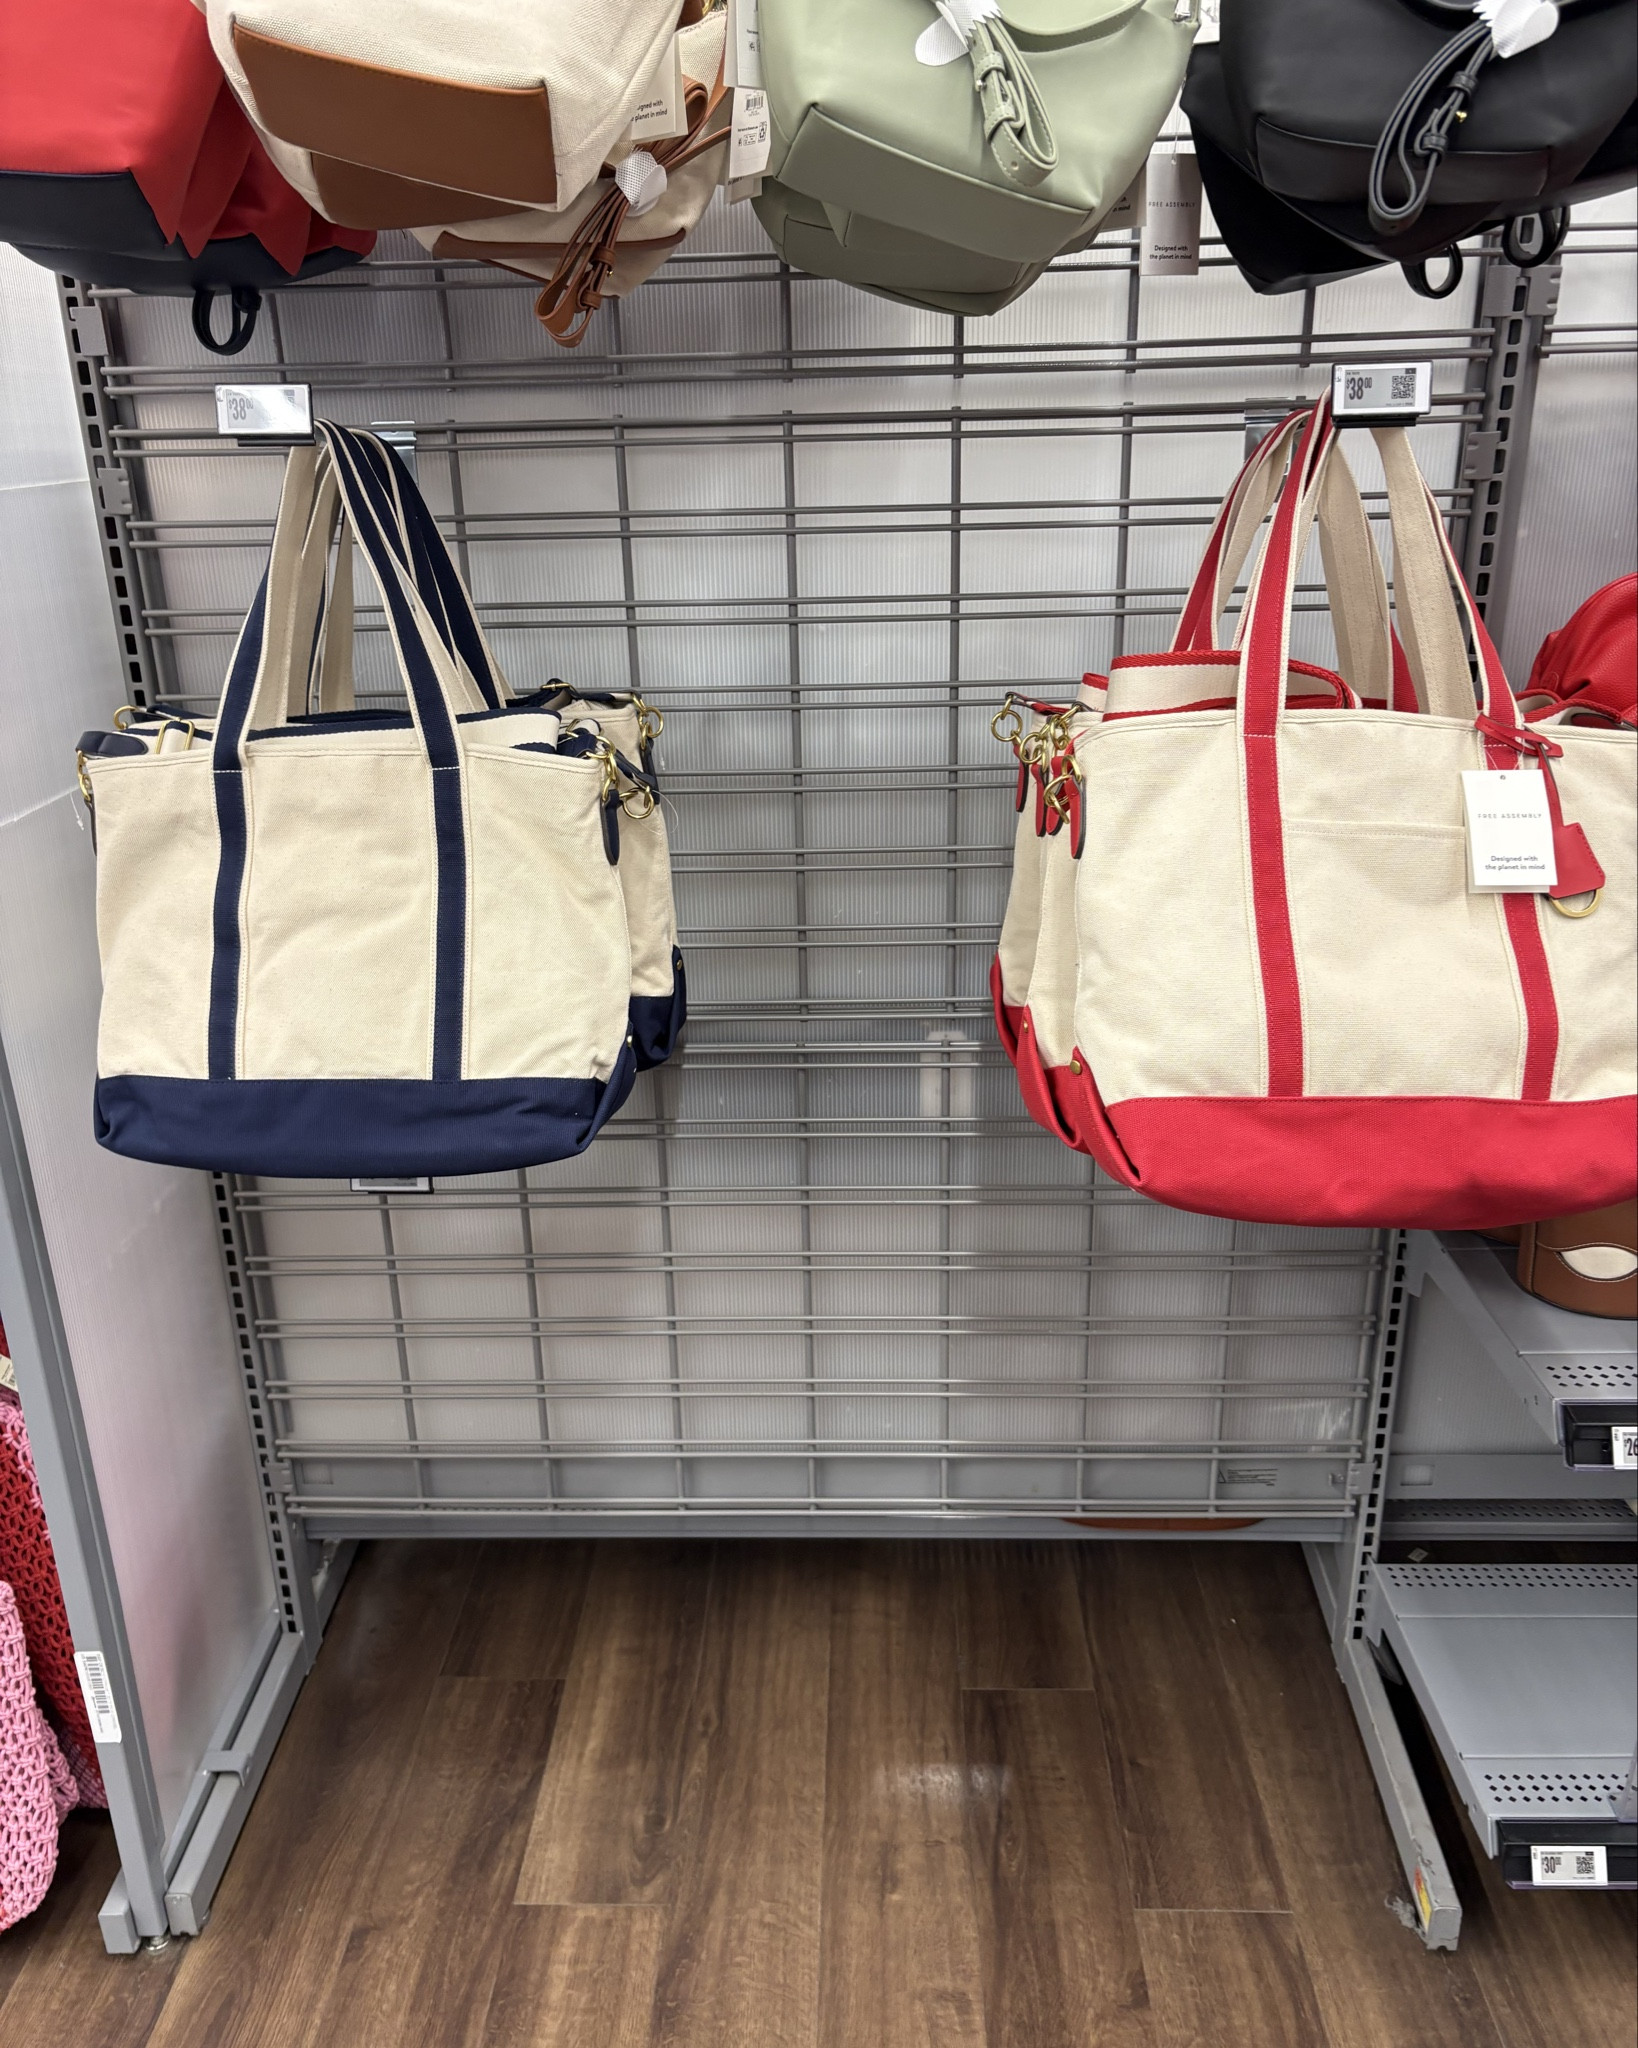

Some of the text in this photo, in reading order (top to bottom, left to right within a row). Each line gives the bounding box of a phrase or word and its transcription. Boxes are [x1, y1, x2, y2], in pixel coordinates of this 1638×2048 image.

[635, 113, 650, 123] planet
[656, 108, 668, 117] mind
[1154, 244, 1189, 253] Designed with
[1158, 253, 1174, 261] planet
[1490, 855, 1522, 863] Designed
[1497, 863, 1519, 871] planet
